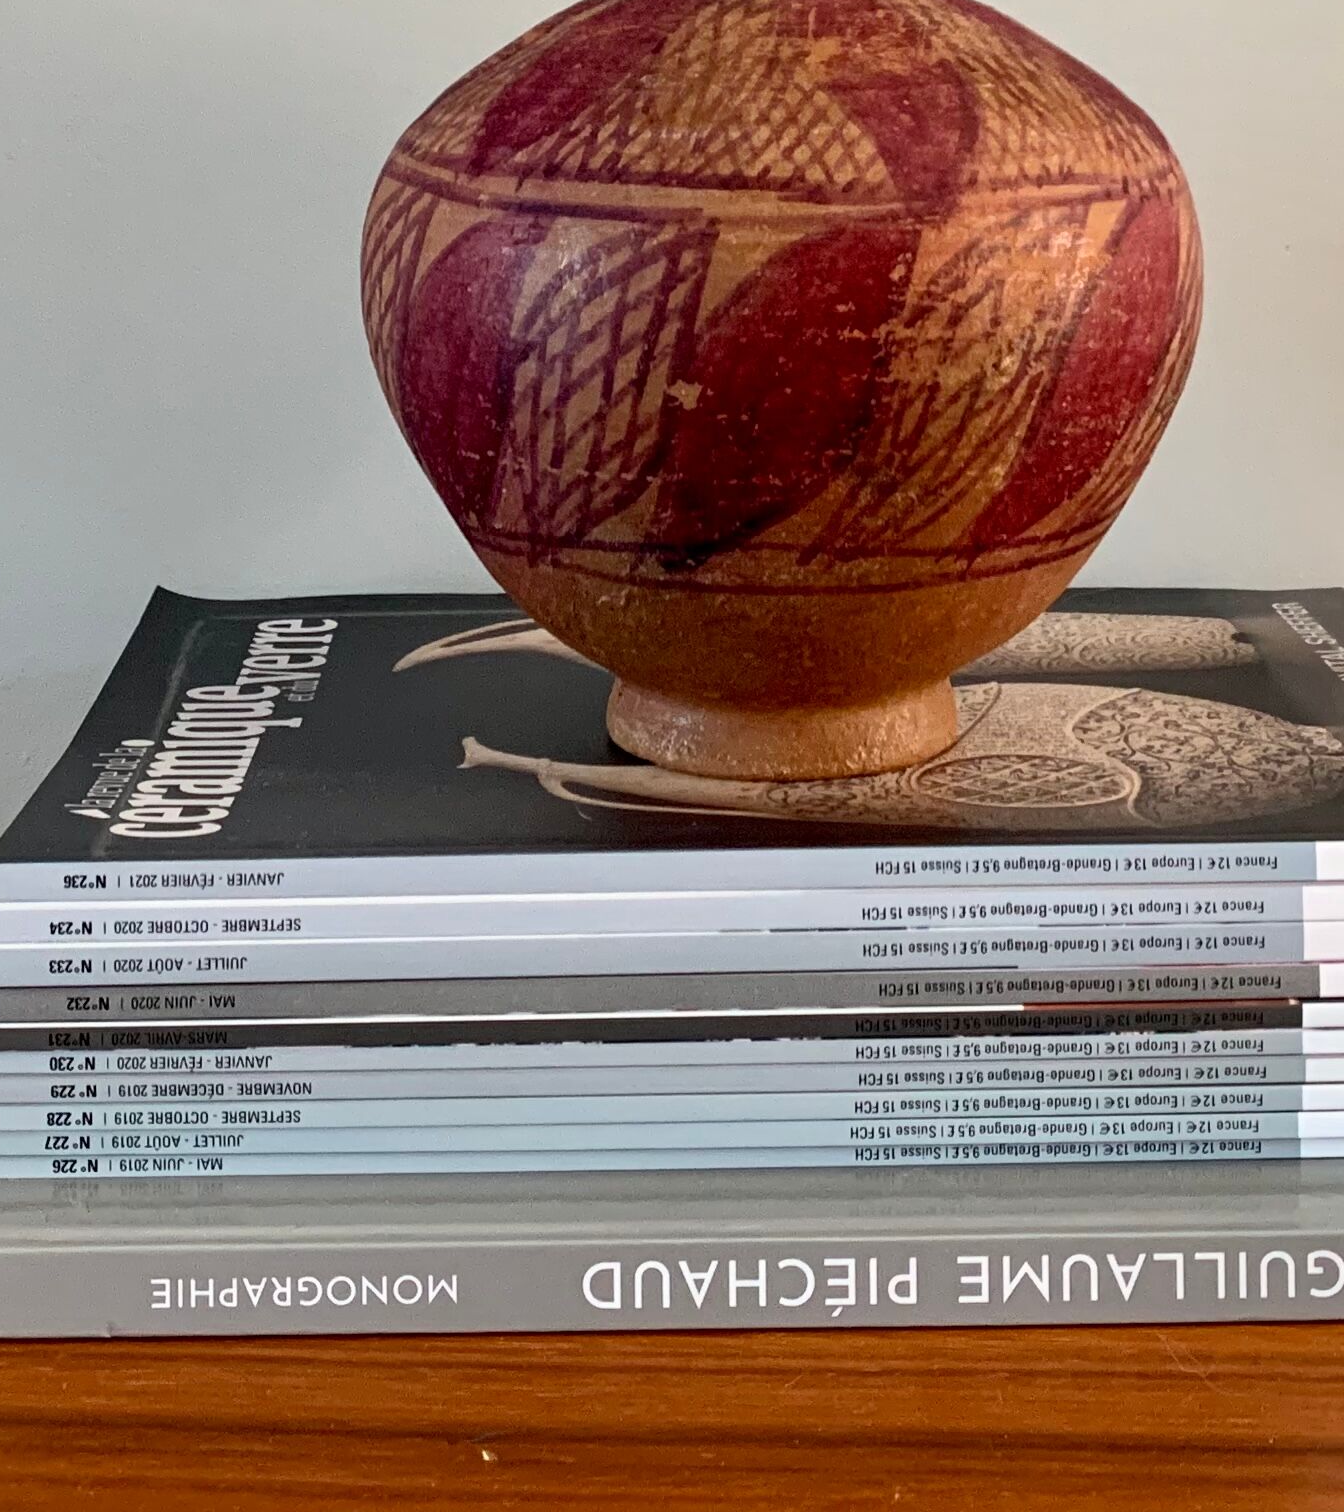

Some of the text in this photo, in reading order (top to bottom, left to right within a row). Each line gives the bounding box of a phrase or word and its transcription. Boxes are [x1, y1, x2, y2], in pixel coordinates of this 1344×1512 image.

[235, 618, 339, 685] verre
[875, 861, 900, 876] FCH
[902, 860, 916, 875] 15
[920, 859, 962, 875] Suisse
[1003, 856, 1112, 873] Grande-Bretagne
[1151, 855, 1196, 872] Europe
[1234, 855, 1278, 870] France
[128, 874, 158, 889] 2021
[160, 873, 215, 891] FÉVRIER
[226, 872, 285, 887] JANVIER
[862, 906, 887, 921] FCH
[889, 906, 903, 921] 15
[907, 905, 948, 921] Suisse
[990, 901, 1098, 919] Grande-Bretagne
[1138, 899, 1182, 916] Europe
[1222, 900, 1265, 915] France
[113, 920, 144, 935] 2020
[146, 919, 210, 934] OCTOBRE
[220, 917, 302, 933] SEPTEMBRE
[890, 943, 904, 957] 15
[908, 941, 950, 957] Suisse
[990, 937, 1100, 955] Grande-Bretagne
[1138, 935, 1183, 951] Europe
[1222, 935, 1266, 950] France
[862, 943, 888, 958] FCH
[113, 958, 144, 973] 2020
[145, 957, 184, 975] AOÛT
[194, 956, 248, 972] JUILLET
[906, 982, 920, 996] 15
[924, 981, 966, 996] Suisse
[1006, 977, 1116, 994] Grande-Bretagne
[1154, 974, 1199, 992] Europe
[1238, 975, 1282, 990] France
[878, 983, 904, 998] FCH
[130, 996, 161, 1011] 2020
[164, 995, 198, 1010] JUIN
[208, 994, 236, 1009] MAI
[110, 1031, 142, 1047] 2020
[116, 1055, 146, 1071] 2020
[149, 1055, 204, 1073] FÉVRIER
[214, 1054, 274, 1070] JANVIER
[858, 1072, 884, 1087] FCH
[886, 1072, 900, 1086] 15
[904, 1071, 946, 1086] Suisse
[986, 1067, 1096, 1084] Grande-Bretagne
[1138, 1064, 1182, 1081] Europe
[1224, 1065, 1268, 1080] France
[118, 1083, 148, 1098] 2019
[150, 1082, 225, 1100] DÉCEMBRE
[236, 1082, 312, 1096] NOVEMBRE
[114, 1111, 144, 1126] 2019
[146, 1110, 210, 1125] OCTOBRE
[220, 1109, 302, 1125] SEPTEMBRE
[848, 1126, 875, 1140] FCH
[878, 1125, 891, 1139] 15
[895, 1124, 937, 1140] Suisse
[978, 1120, 1088, 1137] Grande-Bretagne
[1130, 1119, 1174, 1136] Europe
[1216, 1119, 1260, 1134] France
[111, 1135, 142, 1149] 2019
[143, 1134, 182, 1152] AOÛT
[191, 1134, 245, 1148] JUILLET
[119, 1158, 150, 1172] 2019
[152, 1157, 185, 1172] JUIN
[196, 1157, 224, 1171] MAI
[150, 1273, 458, 1310] MONOGRAPHIE
[582, 1258, 918, 1318] PIÉCHAUD
